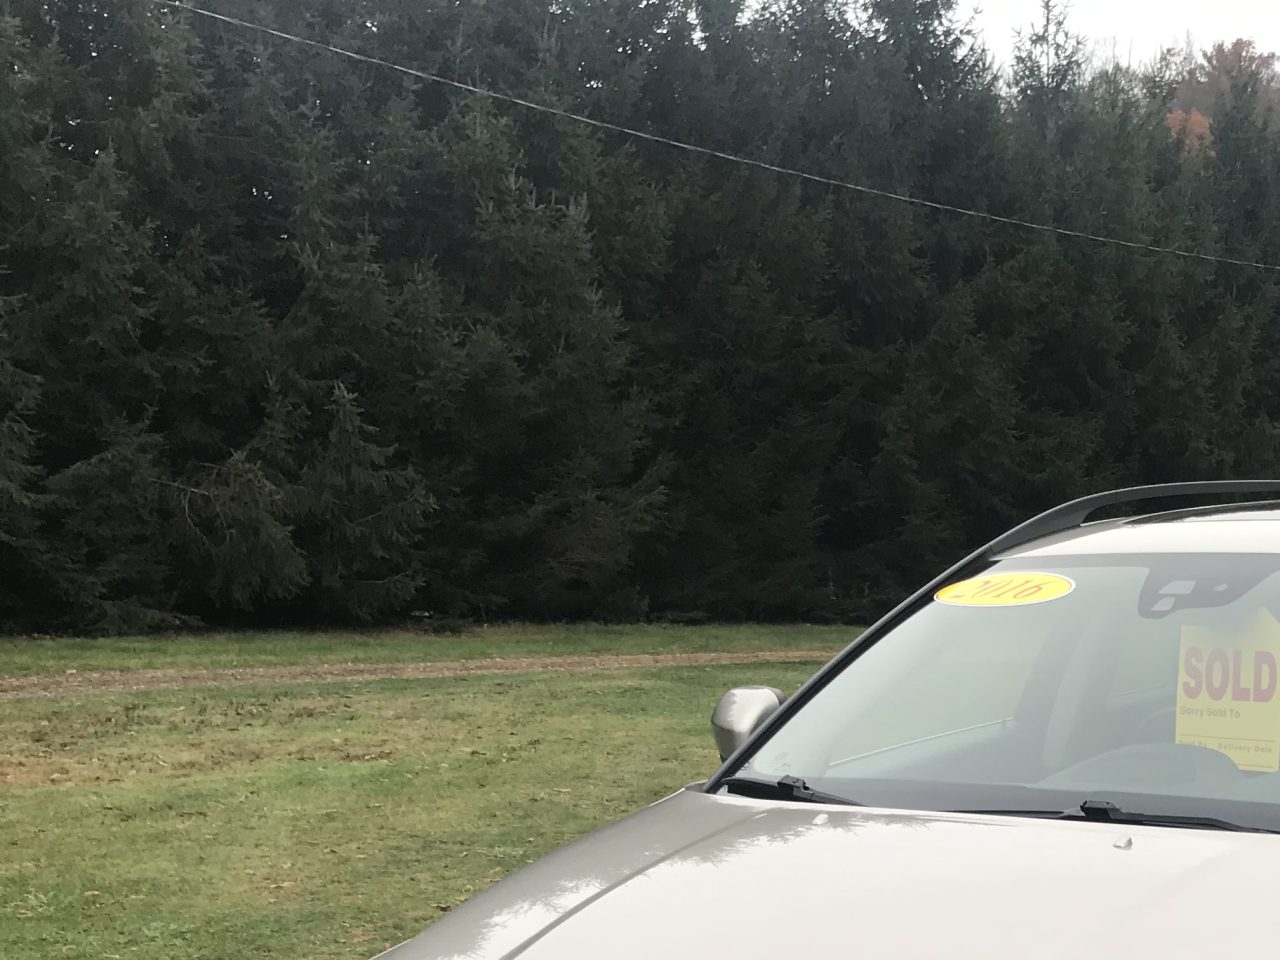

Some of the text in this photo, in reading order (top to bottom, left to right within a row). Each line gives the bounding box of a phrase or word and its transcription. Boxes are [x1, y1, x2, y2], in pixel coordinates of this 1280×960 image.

[1182, 646, 1278, 703] SOLD
[1180, 705, 1241, 719] Sorry Sold To
